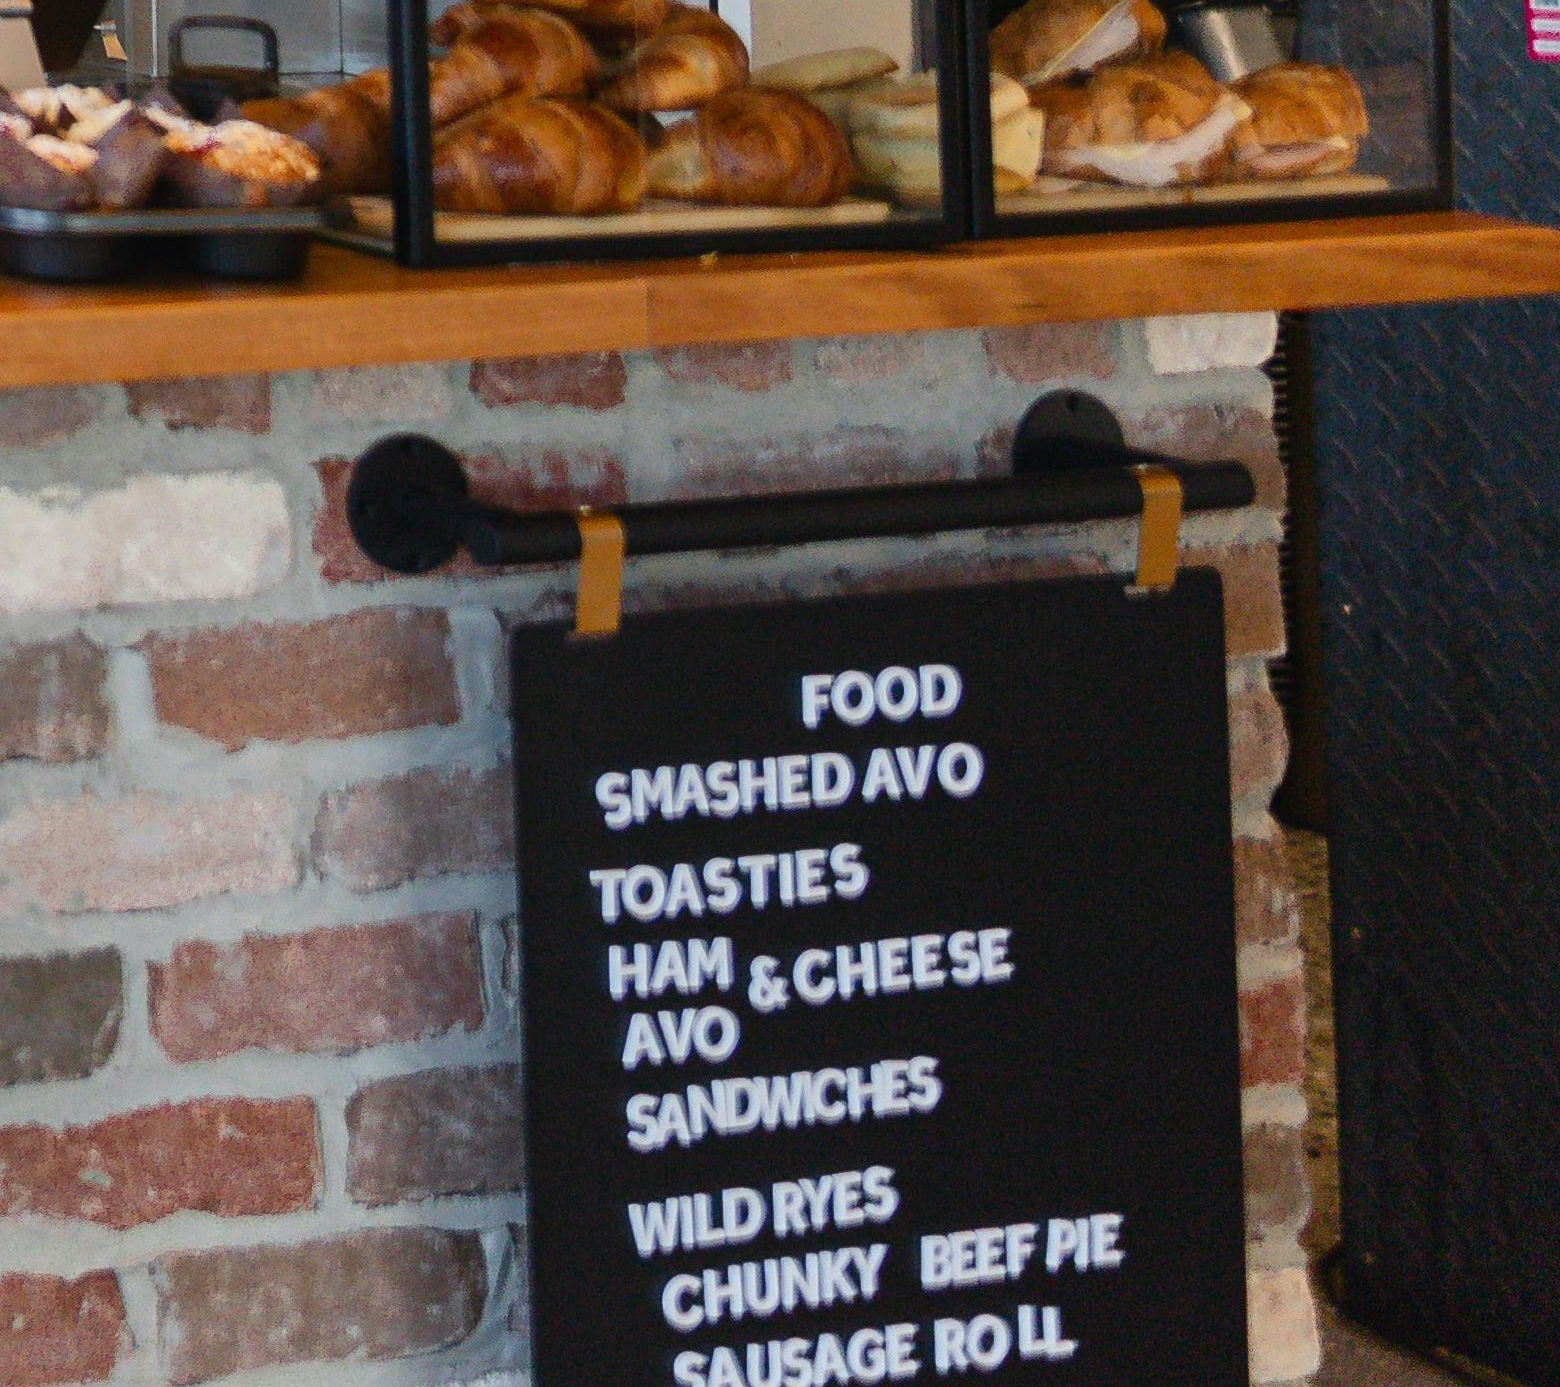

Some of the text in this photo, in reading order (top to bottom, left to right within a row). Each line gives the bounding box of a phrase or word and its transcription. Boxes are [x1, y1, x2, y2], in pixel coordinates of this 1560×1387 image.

[801, 664, 962, 728] FOOD
[595, 742, 983, 829] SMASHED AVO
[589, 842, 869, 922] TOASTIES
[608, 927, 1014, 1012] HAM & CHEESE
[621, 1005, 739, 1069] AVO
[625, 1055, 942, 1152] SANDWICHES
[627, 1165, 899, 1256] WILD RYES
[661, 1213, 1124, 1332] CHUNKY BEEF PIE
[673, 1304, 1077, 1387] SAUSAGE ROLL
